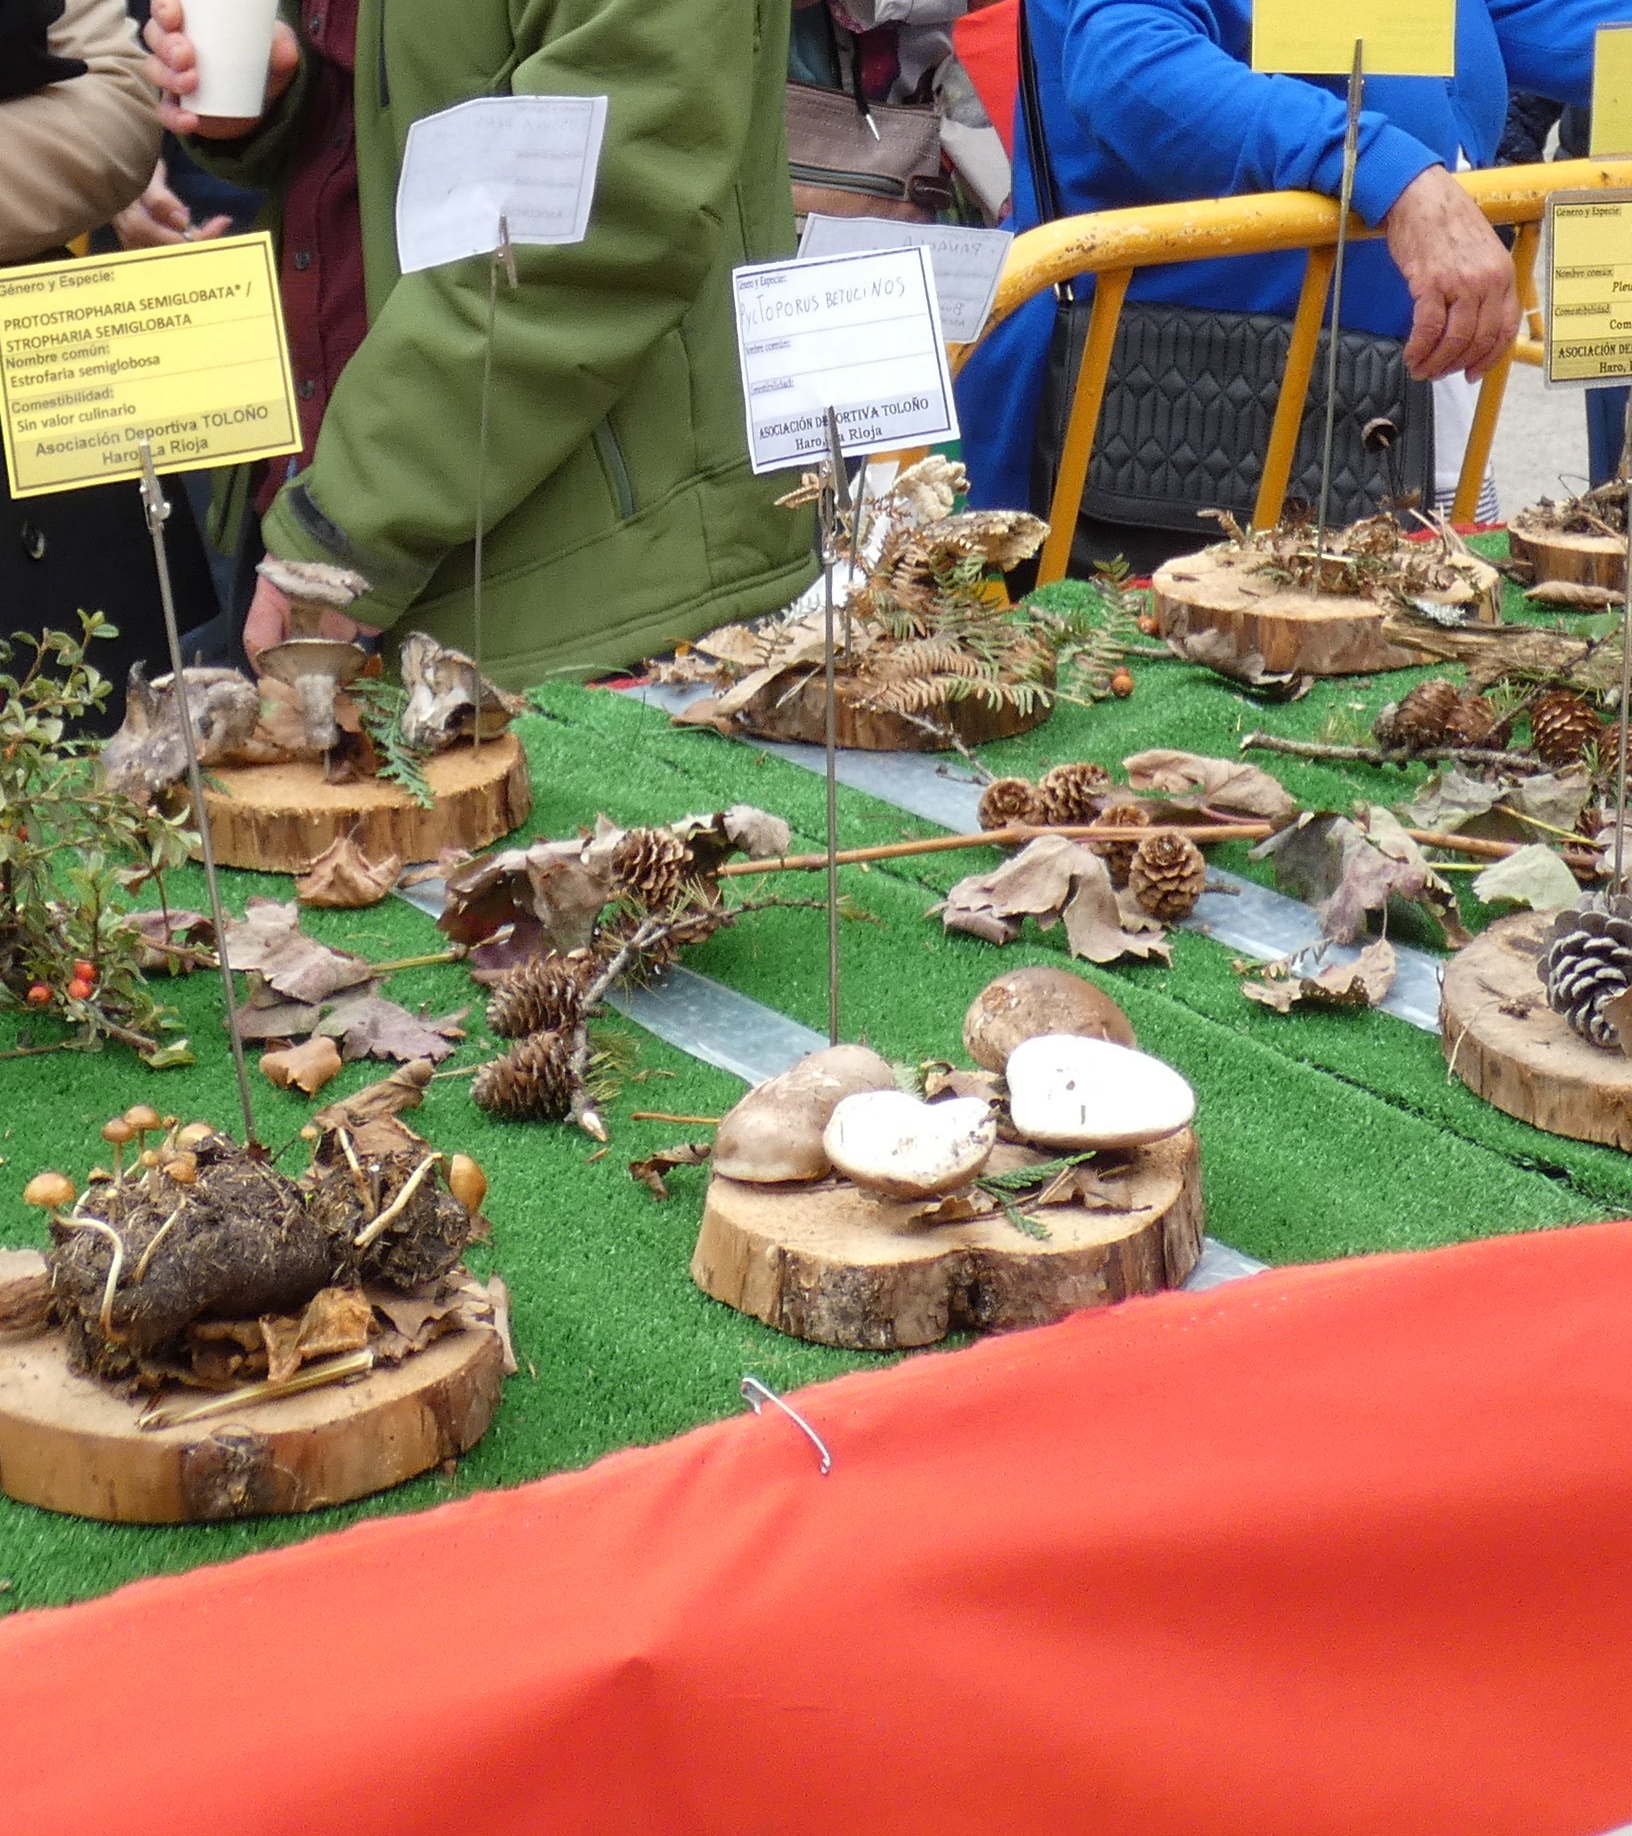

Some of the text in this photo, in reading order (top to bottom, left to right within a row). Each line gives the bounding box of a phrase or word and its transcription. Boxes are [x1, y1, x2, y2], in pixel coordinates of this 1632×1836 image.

[48, 280, 55, 293] y
[60, 270, 115, 289] Especie:
[4, 300, 136, 332] PROTOSTROPHARIA
[6, 314, 192, 352] STROPHARIA SEMIGLOBATA
[6, 344, 110, 370] Nombre común:
[1558, 341, 1616, 358] ASOCIACIÓN
[10, 355, 161, 389] Estrofaria semiglobosa
[1599, 361, 1626, 373] Haro,
[11, 388, 115, 415] Comestibilidad:
[17, 402, 136, 433] Sin valor culinario
[35, 405, 268, 457] Asociación Deportiva TOLOÑO
[759, 396, 929, 440] ASOCIACIÓN DEORTIVA TOLOÑO
[170, 437, 209, 454] Rioja
[795, 437, 827, 451] Haro,
[849, 425, 882, 441] Rioja
